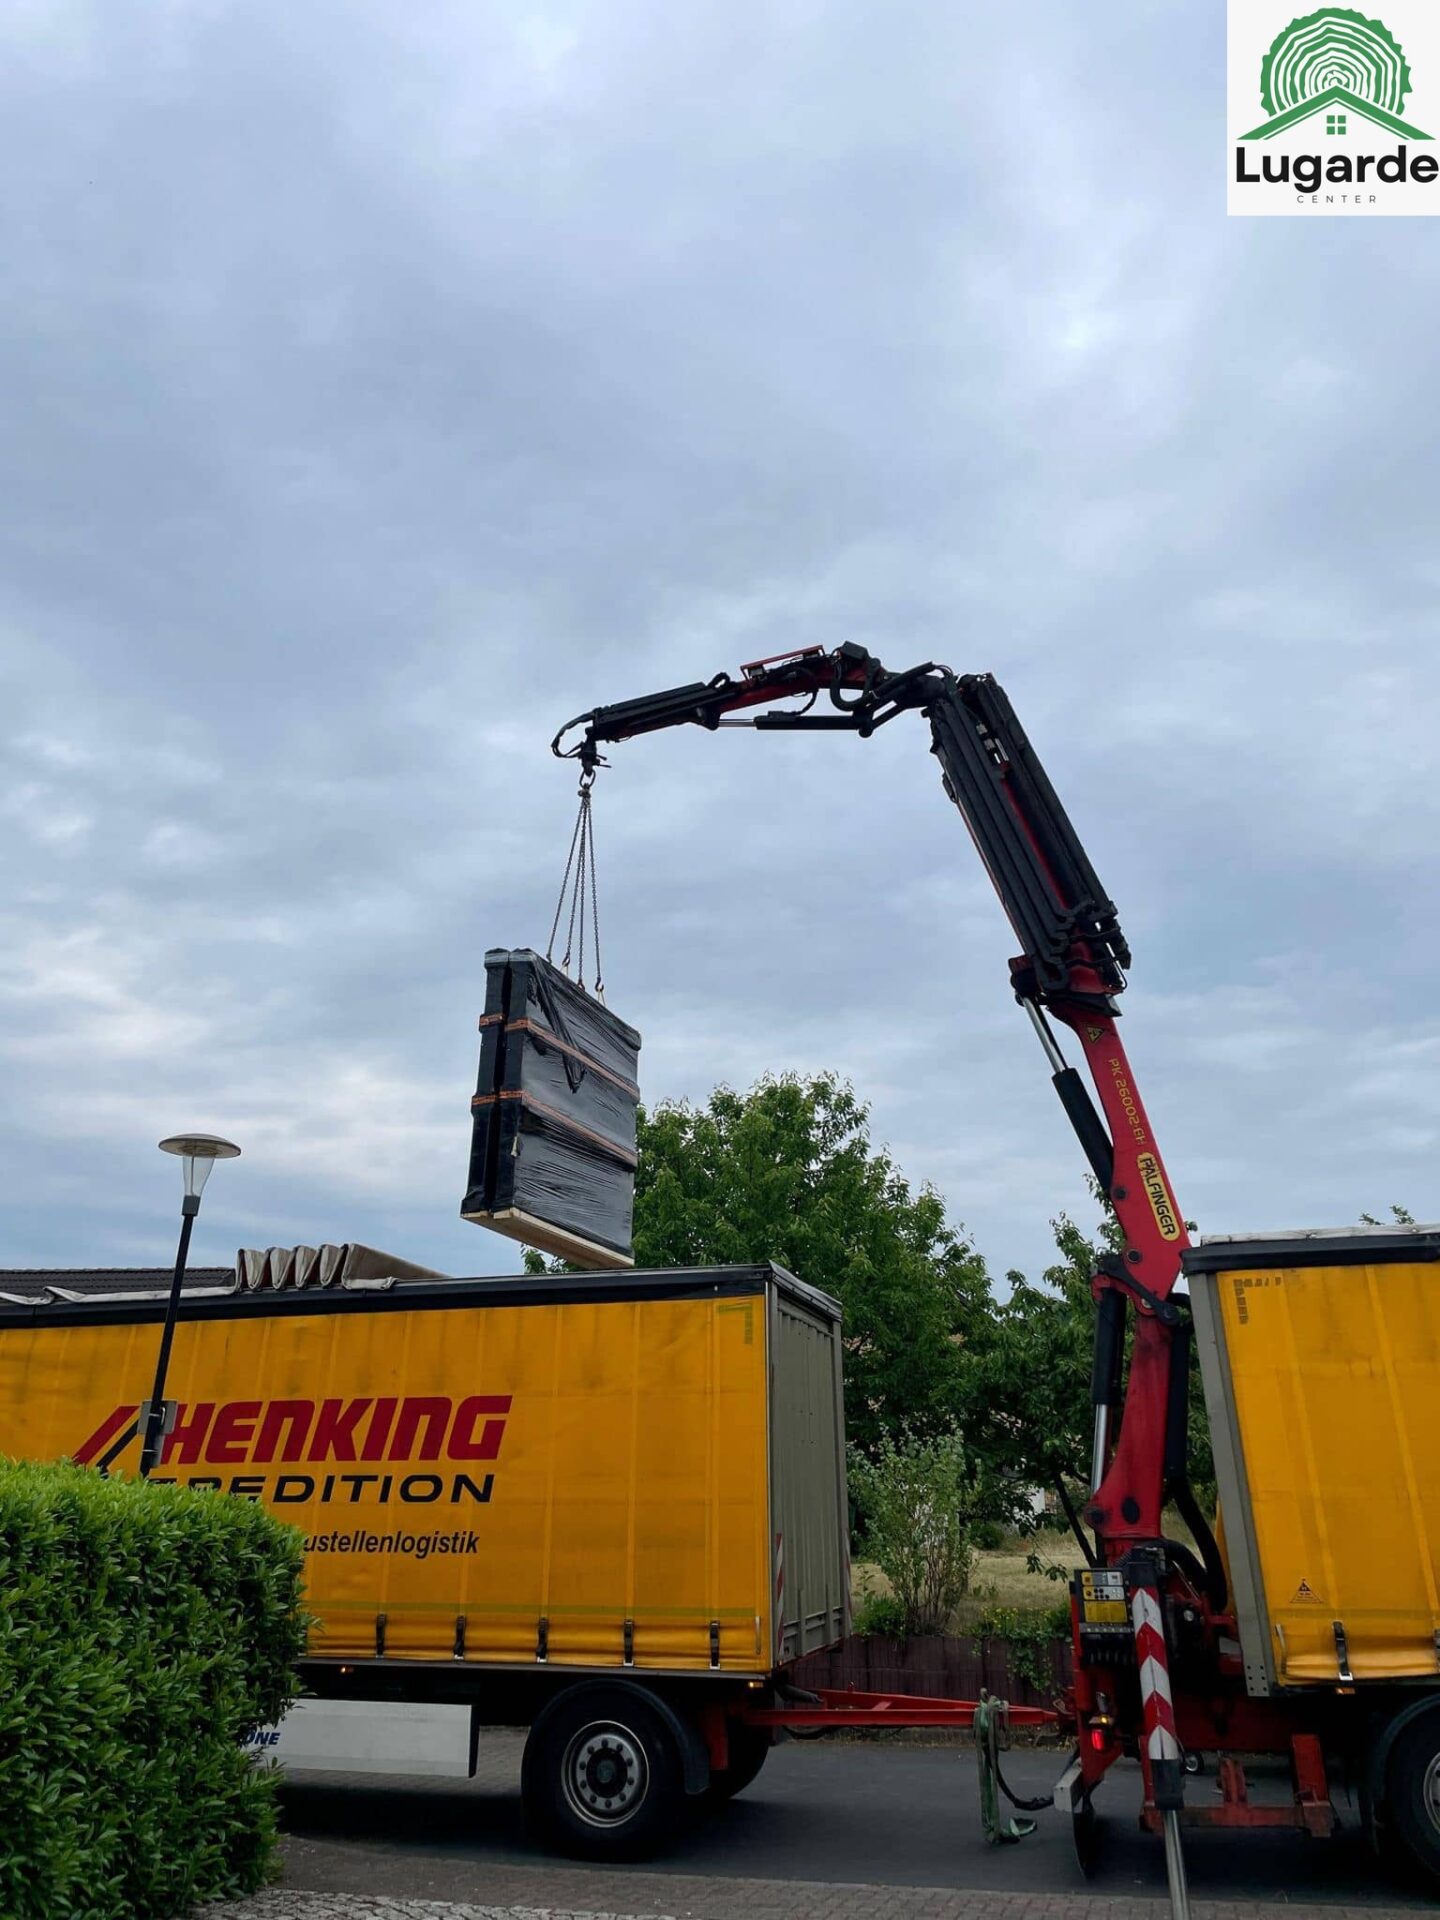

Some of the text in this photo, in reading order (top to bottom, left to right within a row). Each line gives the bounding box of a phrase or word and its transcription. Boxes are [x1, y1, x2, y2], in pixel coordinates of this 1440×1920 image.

[1108, 1058, 1122, 1076] PK
[1141, 1157, 1176, 1236] PALFINGER
[160, 1395, 513, 1464] HENKING
